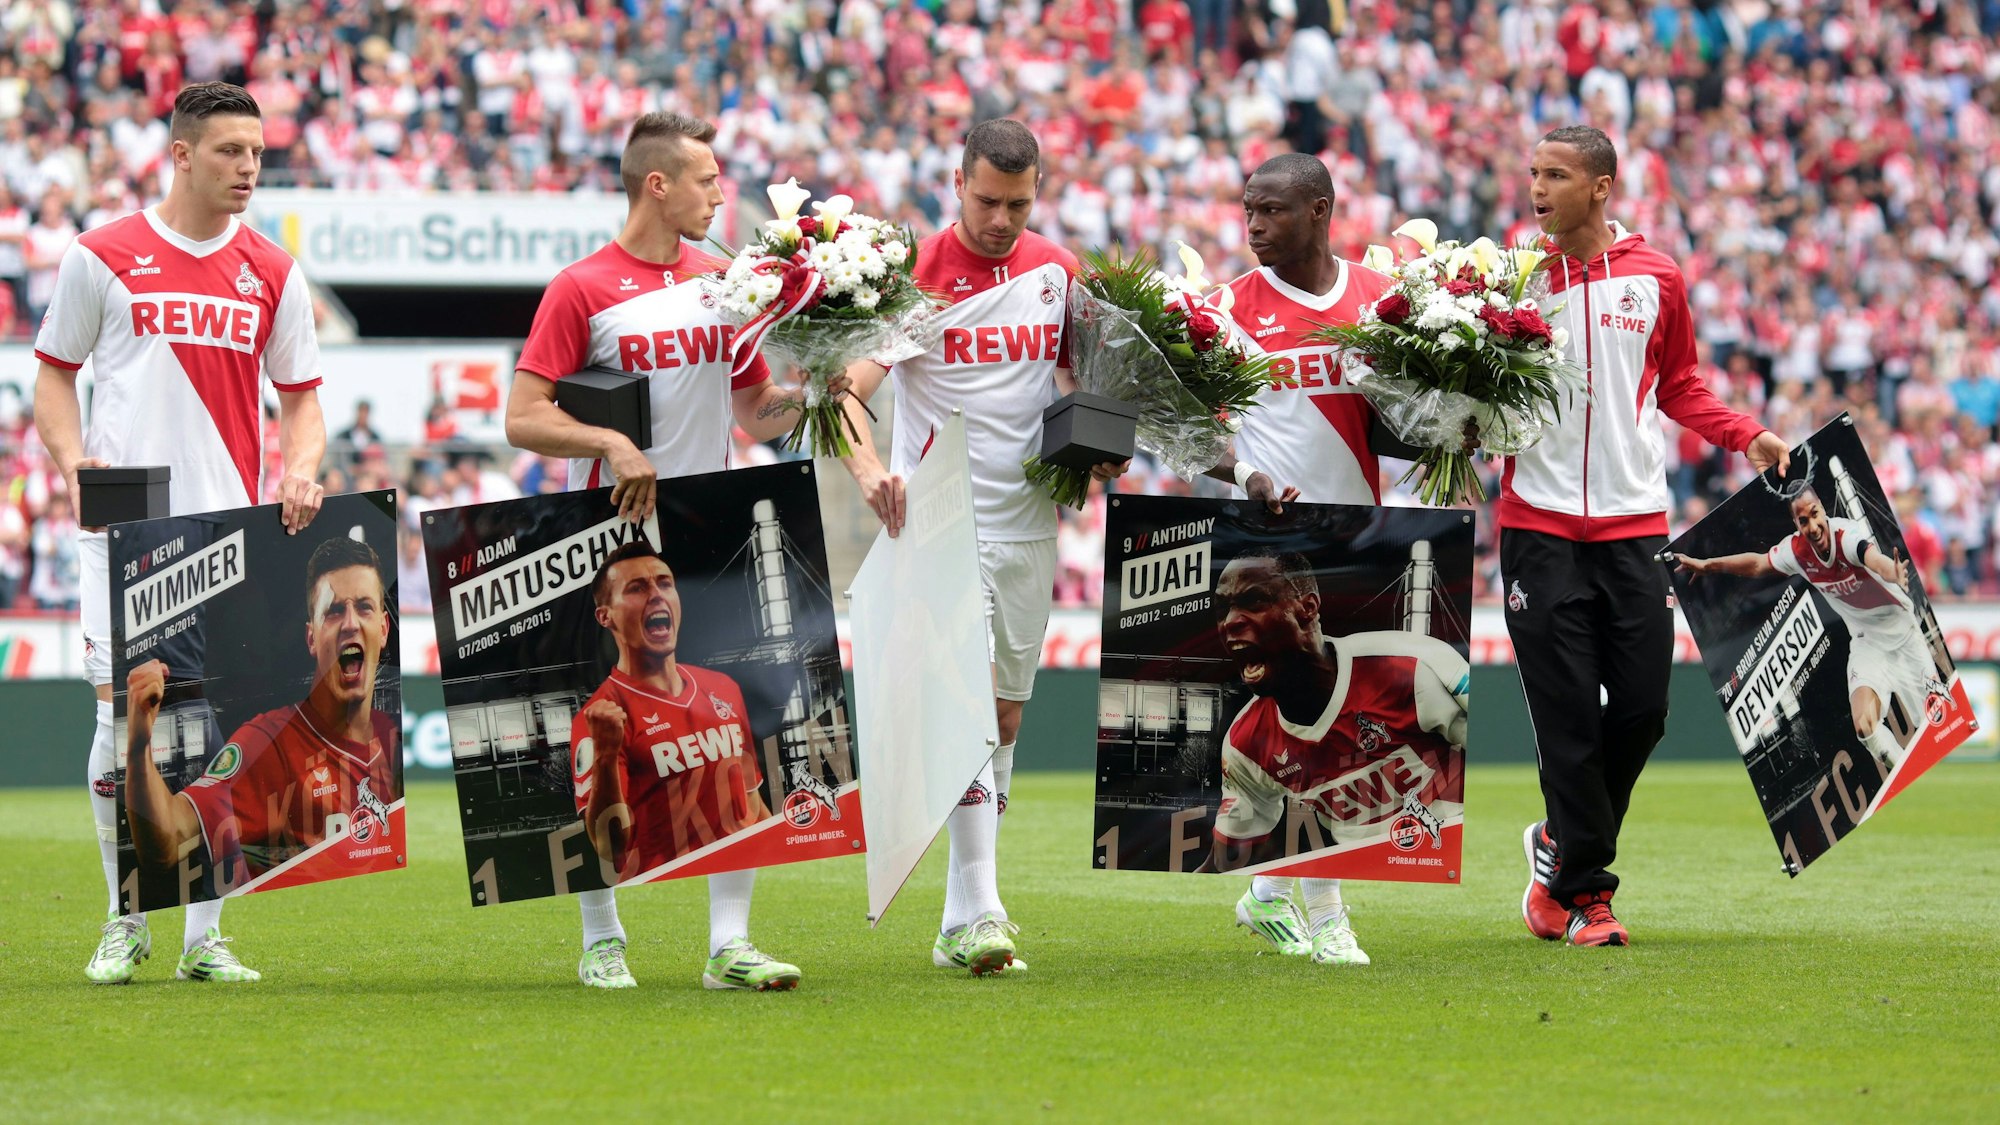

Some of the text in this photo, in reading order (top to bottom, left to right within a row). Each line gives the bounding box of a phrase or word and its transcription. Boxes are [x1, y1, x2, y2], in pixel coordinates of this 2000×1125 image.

[130, 266, 161, 276] erima
[663, 270, 675, 288] 8
[992, 265, 1009, 284] 11
[131, 300, 253, 345] REWE
[1255, 325, 1286, 337] erima
[1600, 313, 1646, 334] REWE
[618, 325, 736, 372] REWE
[944, 323, 1060, 364] REWE
[1123, 537, 1132, 553] 9
[1151, 517, 1215, 547] ANTHONY
[124, 560, 138, 581] 28
[152, 536, 184, 566] KEVIN
[447, 561, 457, 580] 8
[476, 535, 517, 568] ADAM
[131, 543, 238, 628] WIMMER
[1129, 551, 1203, 600] UJAH
[1120, 609, 1160, 629] 08/2012
[1170, 597, 1211, 617] 06/2015
[126, 633, 158, 660] 07/2012
[165, 613, 196, 639] 06/2015
[458, 631, 500, 661] 07/2003
[510, 609, 552, 637] 06/2015
[1721, 682, 1733, 703] 20
[1736, 645, 1757, 680] BRUM
[1754, 619, 1774, 652] SILVA
[1771, 584, 1797, 628] ACOSTA
[1810, 635, 1831, 669] 06/2015
[1735, 602, 1818, 739] DEYVERSON
[502, 733, 524, 741] Energie
[645, 722, 671, 736] erima
[650, 724, 743, 778] REWE
[313, 783, 338, 798] erima
[348, 845, 393, 859] SPÜRBAR ANDERS.
[786, 829, 847, 846] SPÜRBAR ANDERS.
[1387, 855, 1444, 867] SPÜRBAR ANDERS.
